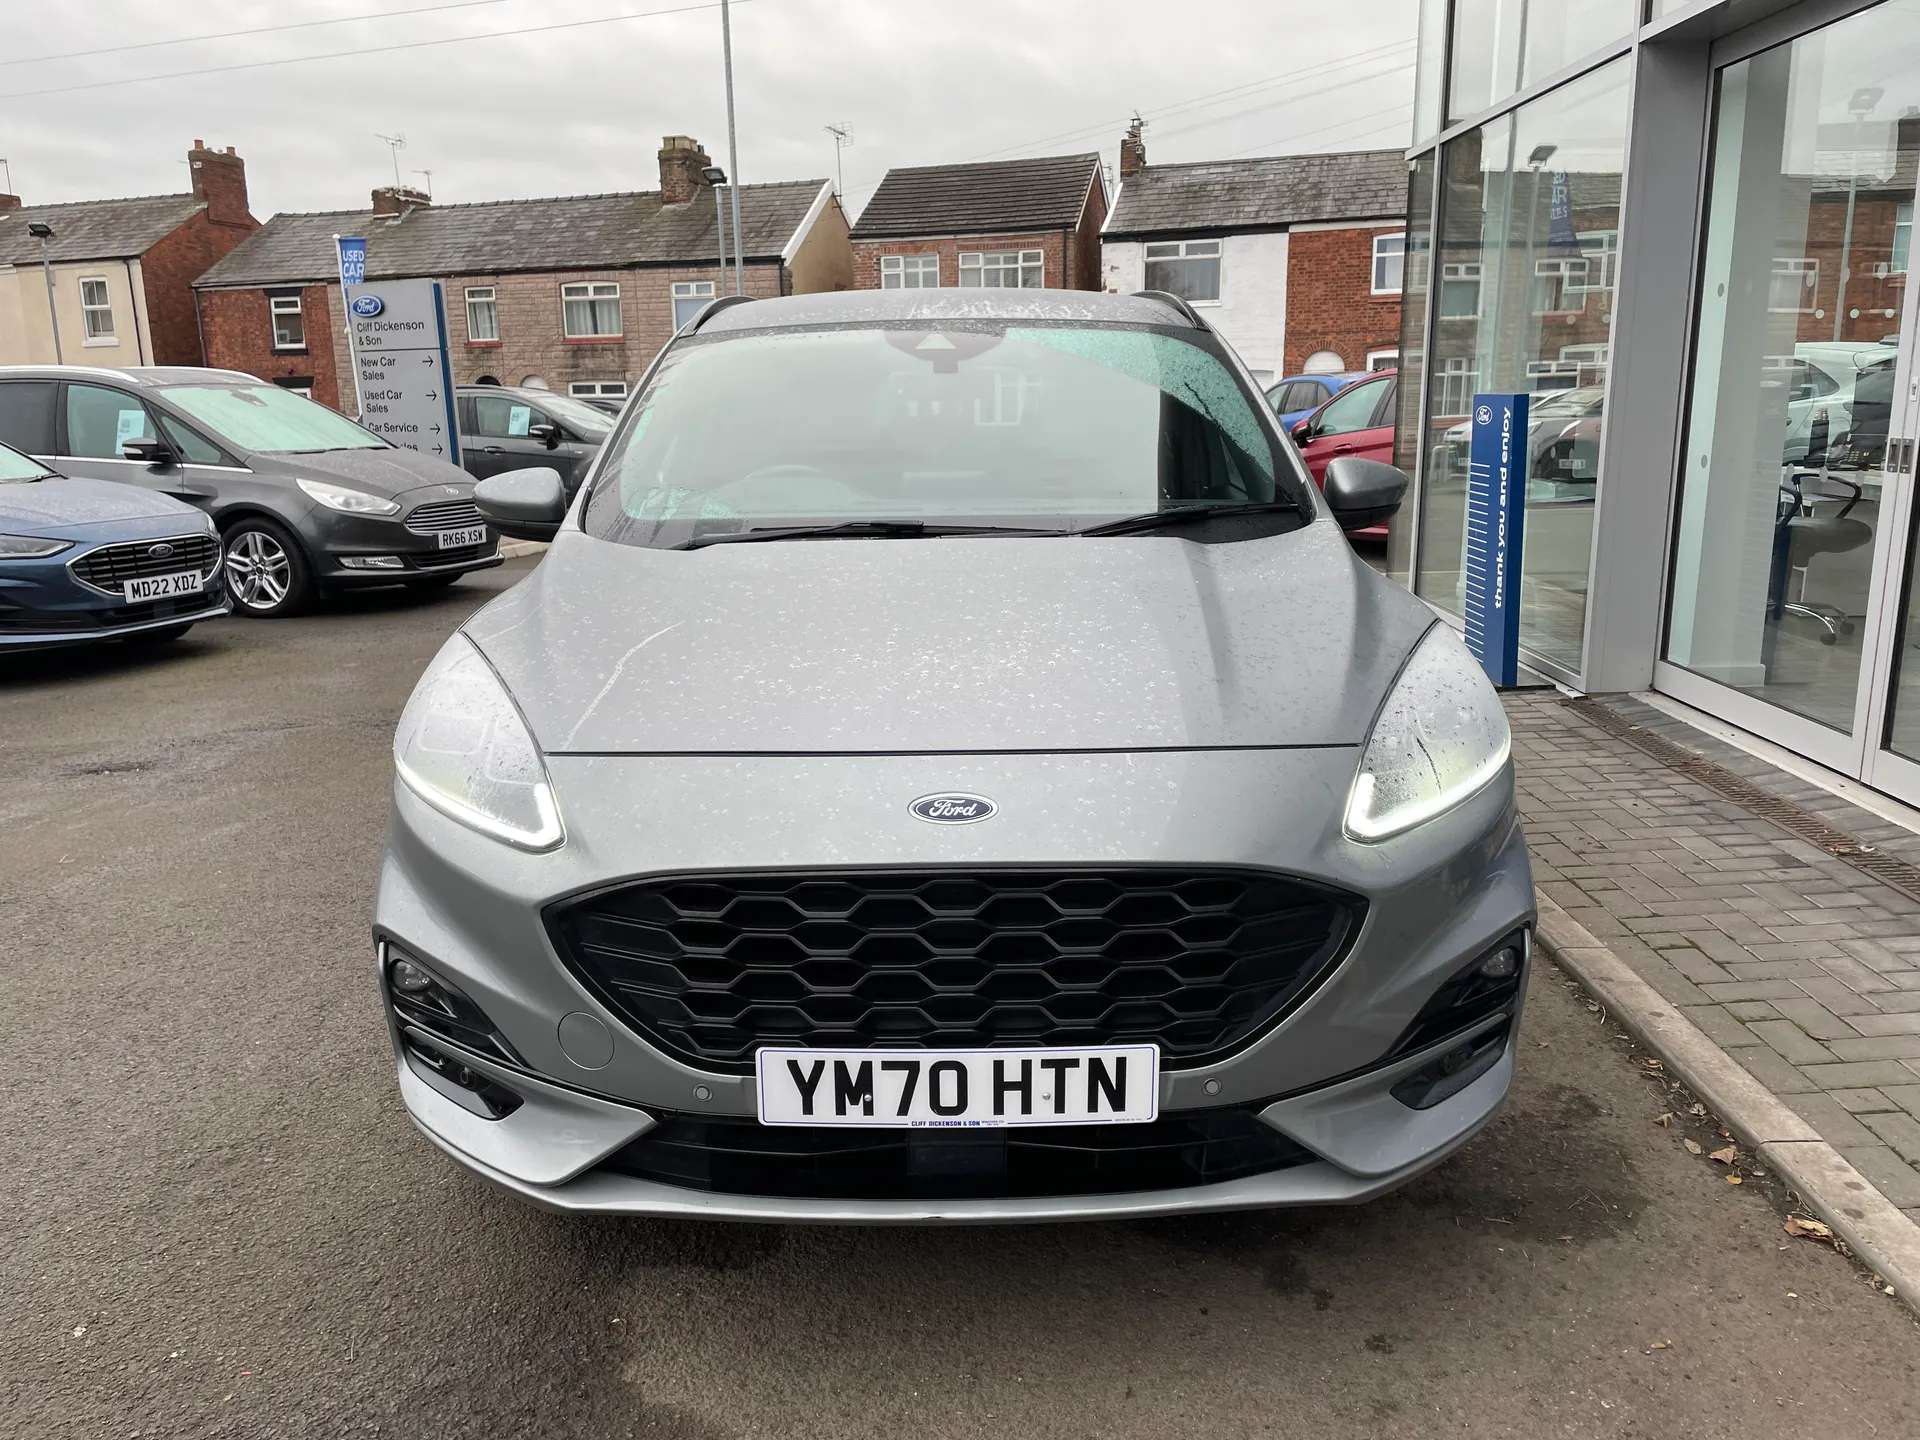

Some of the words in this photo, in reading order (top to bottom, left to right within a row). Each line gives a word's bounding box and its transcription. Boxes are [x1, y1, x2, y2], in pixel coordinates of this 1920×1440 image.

[342, 250, 365, 261] USED
[343, 262, 365, 278] CAR
[356, 299, 375, 313] Ford
[356, 321, 373, 333] Cliff
[374, 320, 425, 332] Dickenson
[358, 336, 364, 346] &
[365, 335, 383, 346] Son
[360, 356, 379, 367] New
[380, 356, 396, 367] Car
[362, 370, 385, 380] Sales
[364, 390, 385, 400] Used
[386, 389, 402, 400] Car
[366, 403, 389, 413] Sales
[368, 422, 382, 433] Car
[383, 422, 418, 433] Service
[1495, 551, 1504, 609] thank
[1502, 406, 1511, 464] enjoy
[442, 531, 467, 547] RK66
[131, 578, 170, 599] MD22
[172, 573, 198, 593] XDZ
[929, 799, 977, 816] Ford
[786, 1058, 969, 1117] YM70
[992, 1056, 1127, 1115] HTN
